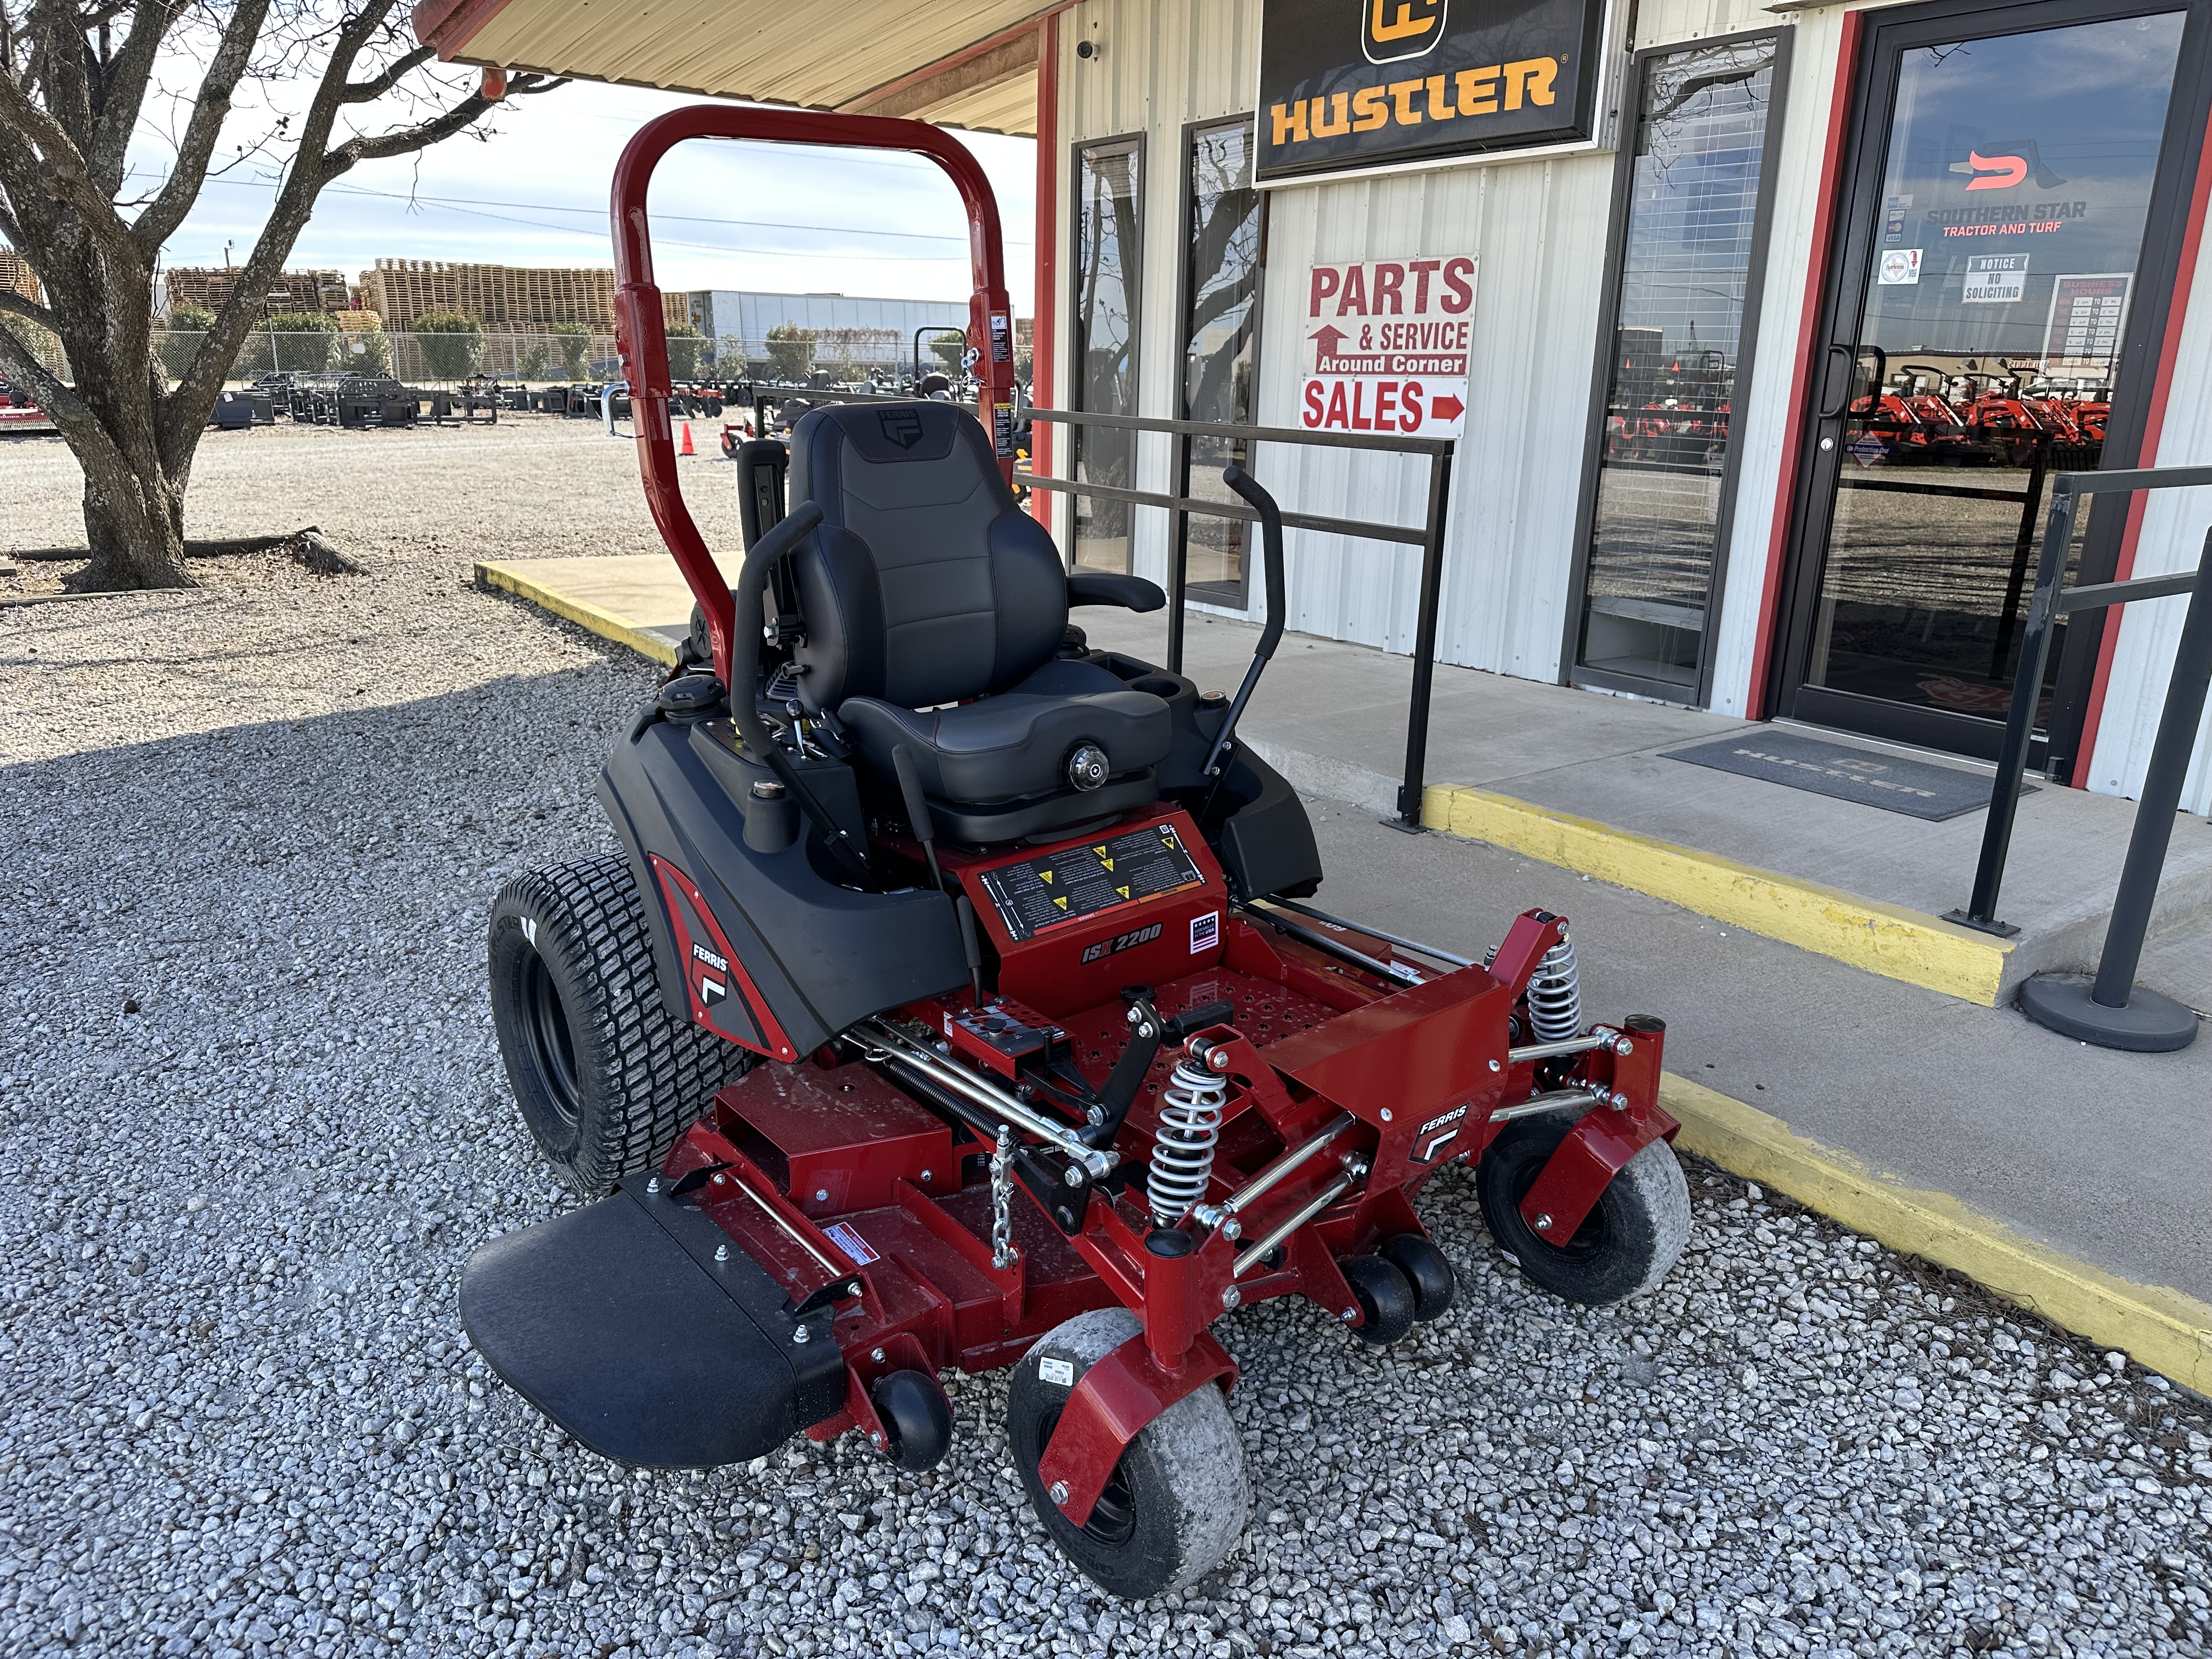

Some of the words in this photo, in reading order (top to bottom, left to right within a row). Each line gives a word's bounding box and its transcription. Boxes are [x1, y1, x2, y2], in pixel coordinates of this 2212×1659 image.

[1271, 57, 1558, 145] HUSTLER
[1927, 205, 2030, 225] SOUTHERN
[2034, 201, 2086, 219] STAR
[1943, 224, 1997, 237] TRACTOR
[1999, 223, 2026, 234] AND
[2029, 222, 2062, 233] TURF
[1980, 258, 2015, 270] NOTICE
[1310, 257, 1474, 317] PARTS
[1988, 273, 2001, 284] NO
[1966, 286, 2019, 299] SOLICITING
[1359, 324, 1372, 351] &
[1380, 322, 1469, 351] SERVICE
[1319, 356, 1385, 372] Around
[1392, 356, 1463, 372] Corner
[880, 410, 916, 419] FERRIS
[1303, 380, 1423, 432] SALES
[1733, 749, 1937, 798] HUSTLER
[1077, 913, 1095, 921] DANGER
[1194, 923, 1214, 933] ASSEMBLED
[1082, 939, 1114, 963] ISX
[1115, 924, 1162, 951] 2200
[693, 944, 727, 972] FERRIS
[1420, 1105, 1467, 1135] FERRIS
[852, 1236, 866, 1249] DANGER
